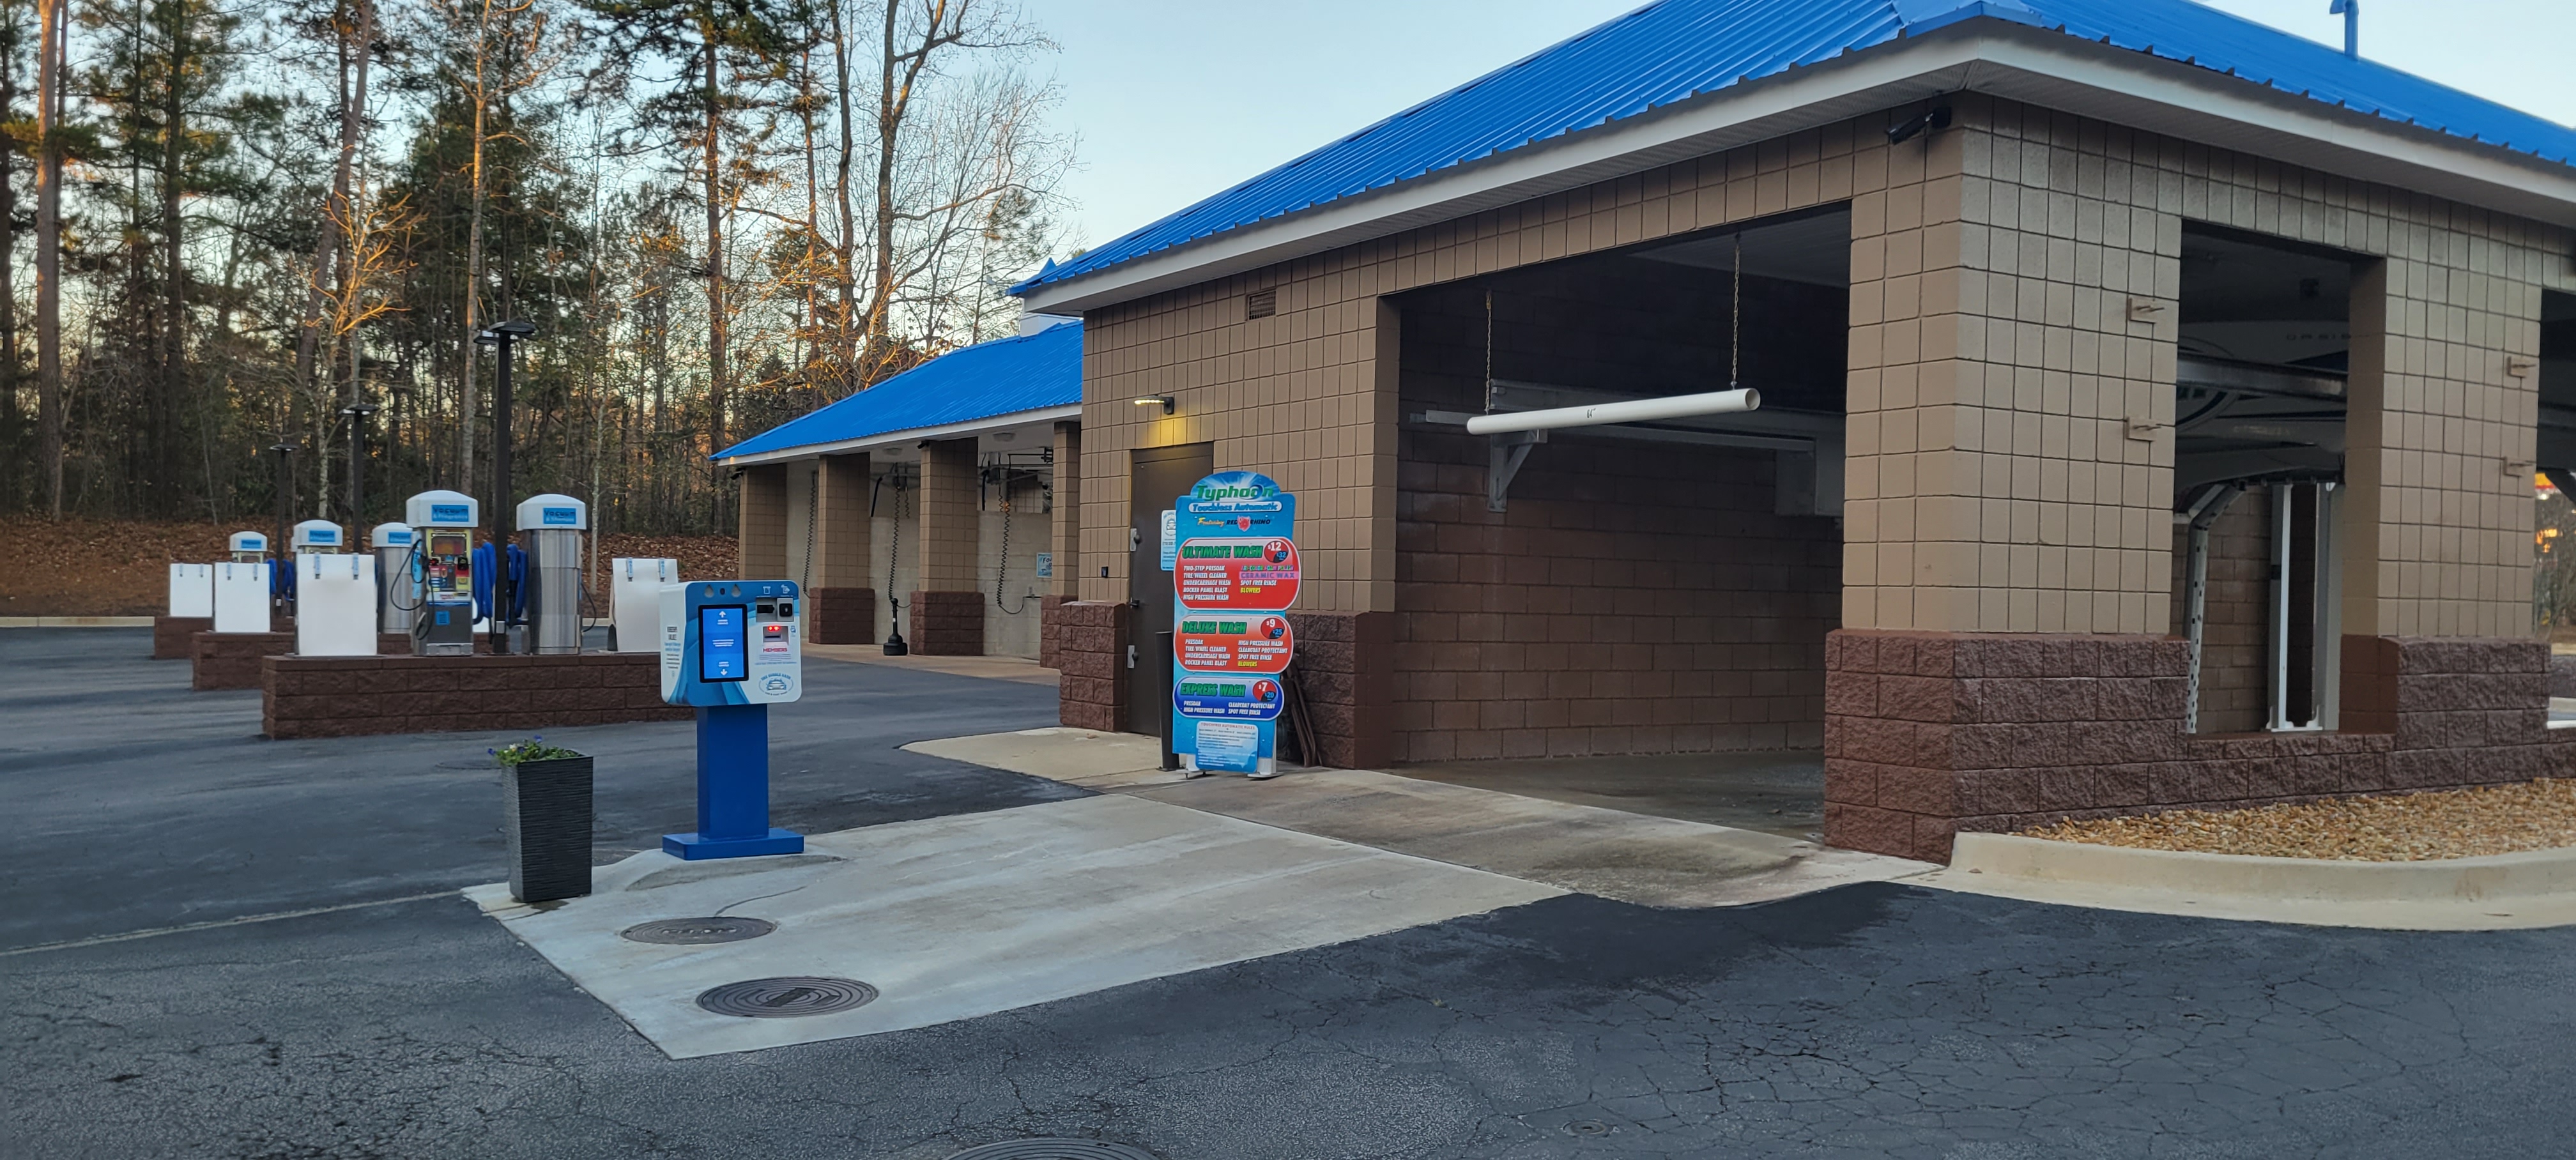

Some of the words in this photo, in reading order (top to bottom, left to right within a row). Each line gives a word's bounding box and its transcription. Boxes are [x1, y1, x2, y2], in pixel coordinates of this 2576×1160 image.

[1196, 485, 1274, 501] Typhoon
[1192, 503, 1232, 512] Touchless
[1234, 502, 1278, 512] Automatic
[1181, 546, 1232, 559] ULTIMATE
[1233, 546, 1264, 558] WASH
[1182, 621, 1217, 634] DELUXE
[1218, 622, 1247, 634] WASH
[1181, 683, 1218, 696] EXPRESS
[1219, 684, 1246, 698] WASH
